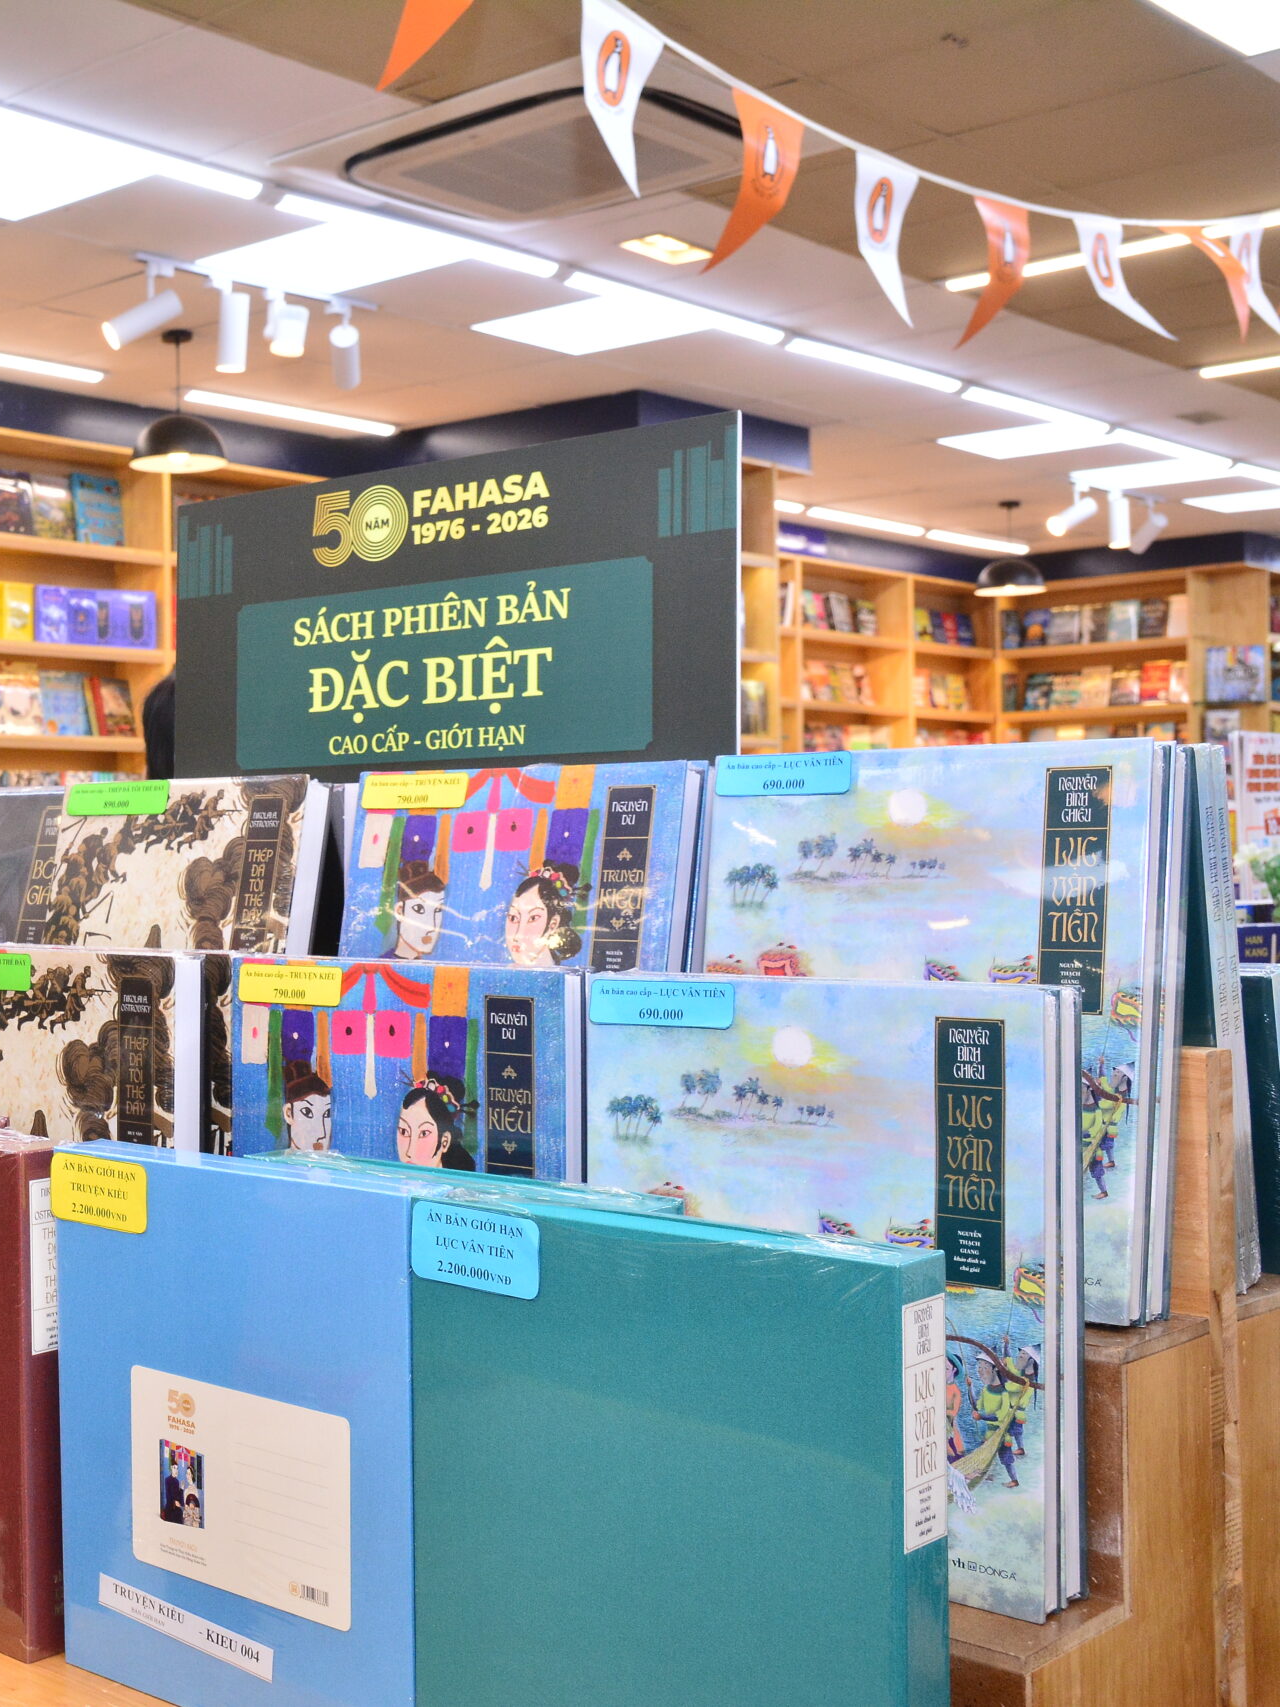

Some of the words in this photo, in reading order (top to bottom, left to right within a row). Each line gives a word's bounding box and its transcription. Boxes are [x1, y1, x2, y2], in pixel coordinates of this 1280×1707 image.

[413, 471, 549, 517] FAHASA
[312, 485, 409, 567] 50
[364, 515, 390, 532] NĂM
[411, 520, 465, 545] 1976
[486, 505, 549, 535] 2026
[293, 607, 374, 647] SÁCH
[384, 592, 488, 639] PHIÊN
[496, 581, 571, 627] BẢN
[308, 649, 410, 724] ĐẶC
[422, 636, 552, 714] BIỆT
[328, 734, 368, 756] CAO
[371, 725, 410, 753] CẤP
[425, 723, 474, 750] GIỚI
[477, 724, 525, 752] HẠN
[762, 779, 805, 790] 690.000
[1058, 773, 1098, 792] NGUYỄN
[1065, 791, 1088, 807] ĐÌNH
[621, 813, 636, 826] DU
[1061, 806, 1092, 823] CHIỂU
[248, 849, 273, 862] THÉP
[1054, 837, 1098, 870] LỤC
[602, 868, 644, 883] TRUYỆN
[244, 892, 265, 907] THẾ
[1051, 873, 1097, 907] VÂN
[1048, 909, 1099, 943] TIÊN
[273, 988, 306, 999] 790.000
[660, 988, 680, 998] LỤC
[681, 987, 702, 997] VÂN
[703, 987, 726, 998] TIÊN
[490, 1011, 528, 1026] NGUYỄN
[639, 1008, 684, 1020] 690.000
[501, 1027, 516, 1040] DU
[949, 1027, 989, 1045] NGUYỄN
[957, 1044, 981, 1062] ĐÌNH
[129, 1068, 143, 1083] TÔI
[953, 1062, 985, 1080] CHIỂU
[126, 1084, 146, 1100] THẾ
[488, 1087, 532, 1105] TRUYỆN
[488, 1104, 532, 1134] KIỀU
[947, 1094, 993, 1132] LỤC
[947, 1134, 993, 1172] VÂN
[77, 1161, 95, 1175] BẢN
[96, 1164, 116, 1178] GIỚI
[117, 1169, 136, 1182] HẠN
[70, 1182, 105, 1198] TRUYỆN
[107, 1186, 129, 1200] KIỀU
[944, 1173, 996, 1212] TIÊN
[71, 1202, 127, 1222] 2.200.000VNĐ
[427, 1208, 442, 1223] ẤN
[445, 1213, 468, 1227] BẢN
[471, 1218, 496, 1233] GIỚI
[499, 1224, 523, 1239] HẠN
[436, 1236, 459, 1250] LỤC
[461, 1239, 484, 1254] VÂN
[487, 1245, 514, 1260] TIÊN
[960, 1247, 980, 1256] GIANG
[437, 1260, 512, 1285] 2.200.000VNĐ
[914, 1367, 936, 1405] LỤC
[168, 1389, 196, 1417] 50
[167, 1415, 196, 1429] FAHASA
[915, 1406, 936, 1442] VÂN
[914, 1441, 938, 1478] TIÊN
[113, 1582, 155, 1610] TRUYỆN
[158, 1603, 185, 1624] KIỀU
[206, 1628, 238, 1653] KIEU
[240, 1643, 260, 1664] 004
